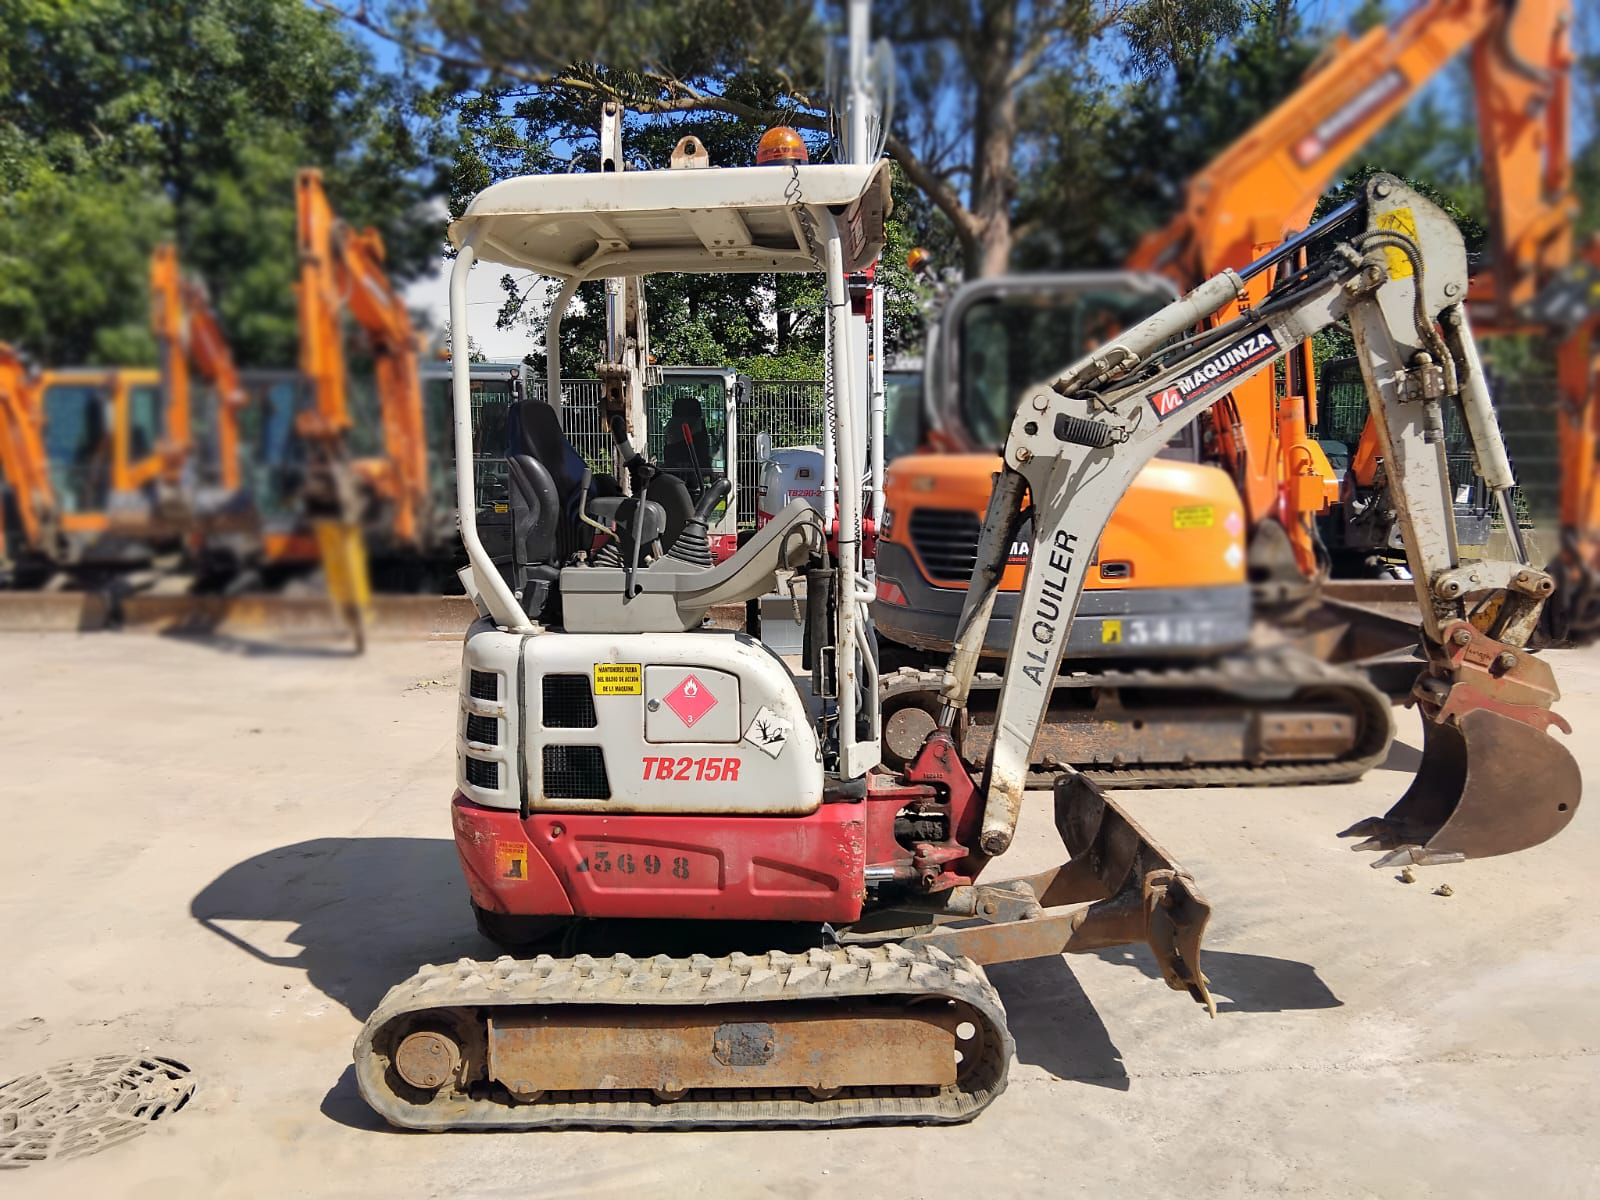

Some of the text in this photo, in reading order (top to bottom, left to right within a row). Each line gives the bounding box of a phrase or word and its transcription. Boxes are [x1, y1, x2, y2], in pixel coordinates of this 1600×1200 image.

[1177, 333, 1273, 395] MAQUINZA
[1022, 529, 1078, 687] ALQUILER
[687, 715, 694, 723] 3
[642, 756, 742, 782] TB215R
